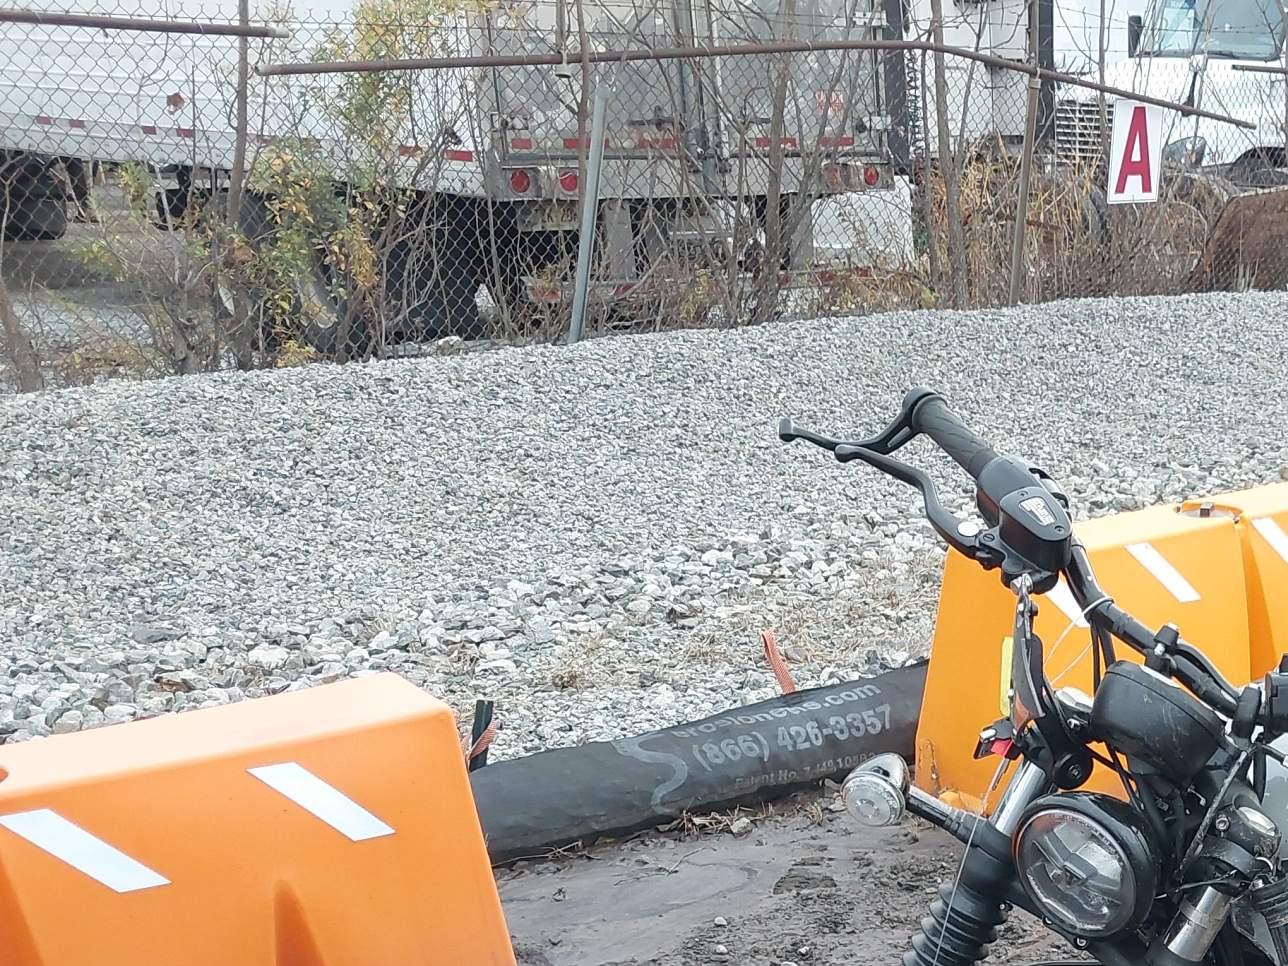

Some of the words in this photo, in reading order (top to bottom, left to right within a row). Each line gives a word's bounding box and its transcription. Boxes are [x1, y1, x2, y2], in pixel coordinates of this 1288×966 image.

[1114, 106, 1152, 194] A
[692, 731, 770, 772] (866)
[776, 703, 892, 751] 426-3357
